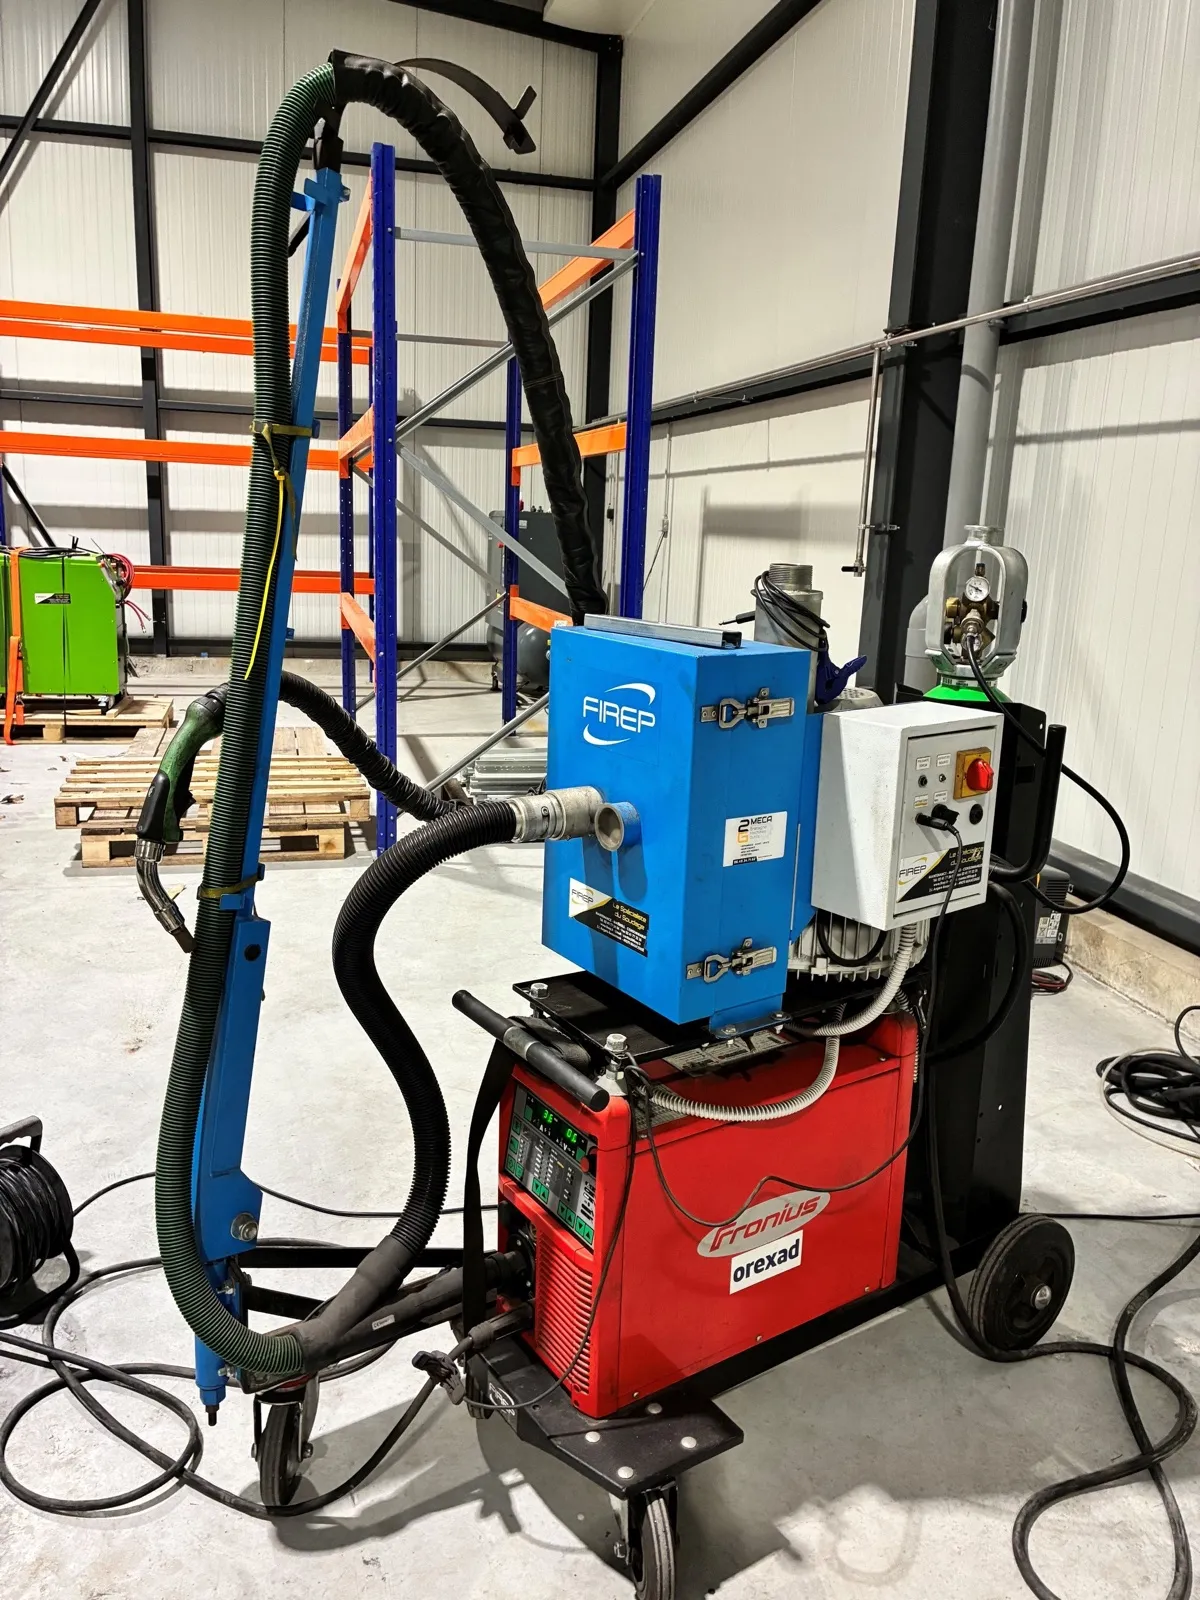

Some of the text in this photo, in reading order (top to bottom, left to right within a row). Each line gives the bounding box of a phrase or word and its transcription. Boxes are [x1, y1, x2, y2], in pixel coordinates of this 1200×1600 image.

[583, 696, 655, 733] FIREP
[750, 816, 772, 825] MECA
[899, 864, 926, 878] FIREP
[571, 889, 594, 904] FIREP
[709, 1195, 821, 1253] Fronius
[733, 1238, 800, 1282] orexad
